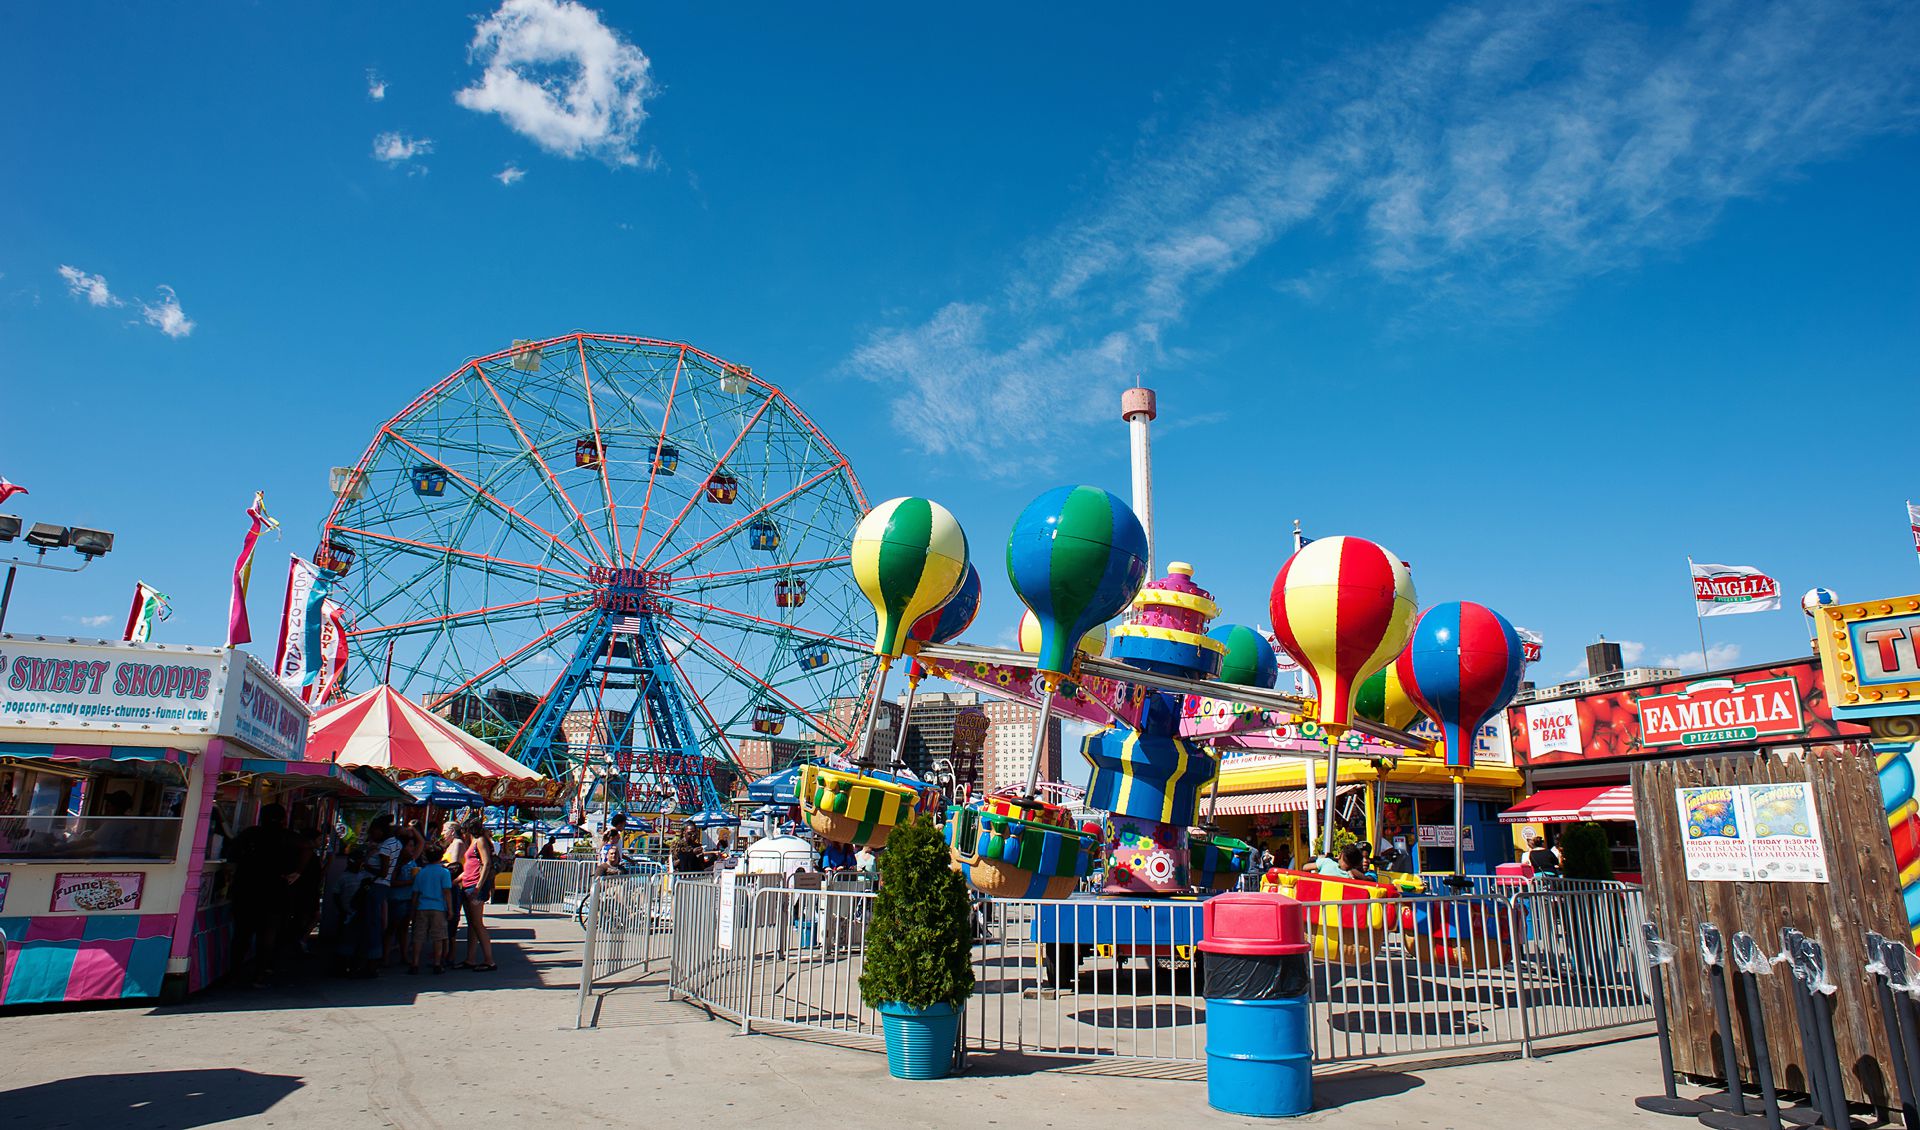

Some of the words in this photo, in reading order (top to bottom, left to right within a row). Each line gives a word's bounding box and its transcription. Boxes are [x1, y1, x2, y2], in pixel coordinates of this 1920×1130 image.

[589, 566, 671, 591] WONDER
[1695, 578, 1772, 597] FAMIGLIA
[291, 572, 307, 628] COTTON
[592, 589, 662, 614] WHEEL
[285, 632, 302, 680] CANDY
[9, 656, 110, 695] SWEET
[113, 662, 211, 700] SHOPPE
[155, 706, 186, 719] funnel
[187, 708, 208, 720] cake
[1532, 713, 1573, 731] SNACK
[1643, 691, 1793, 735] FAMIGLIA
[1542, 728, 1567, 742] BAR
[1690, 731, 1748, 743] PIZZERIA
[616, 751, 717, 777] WONDER
[55, 880, 103, 900] Funnel
[96, 890, 139, 910] Cakes
